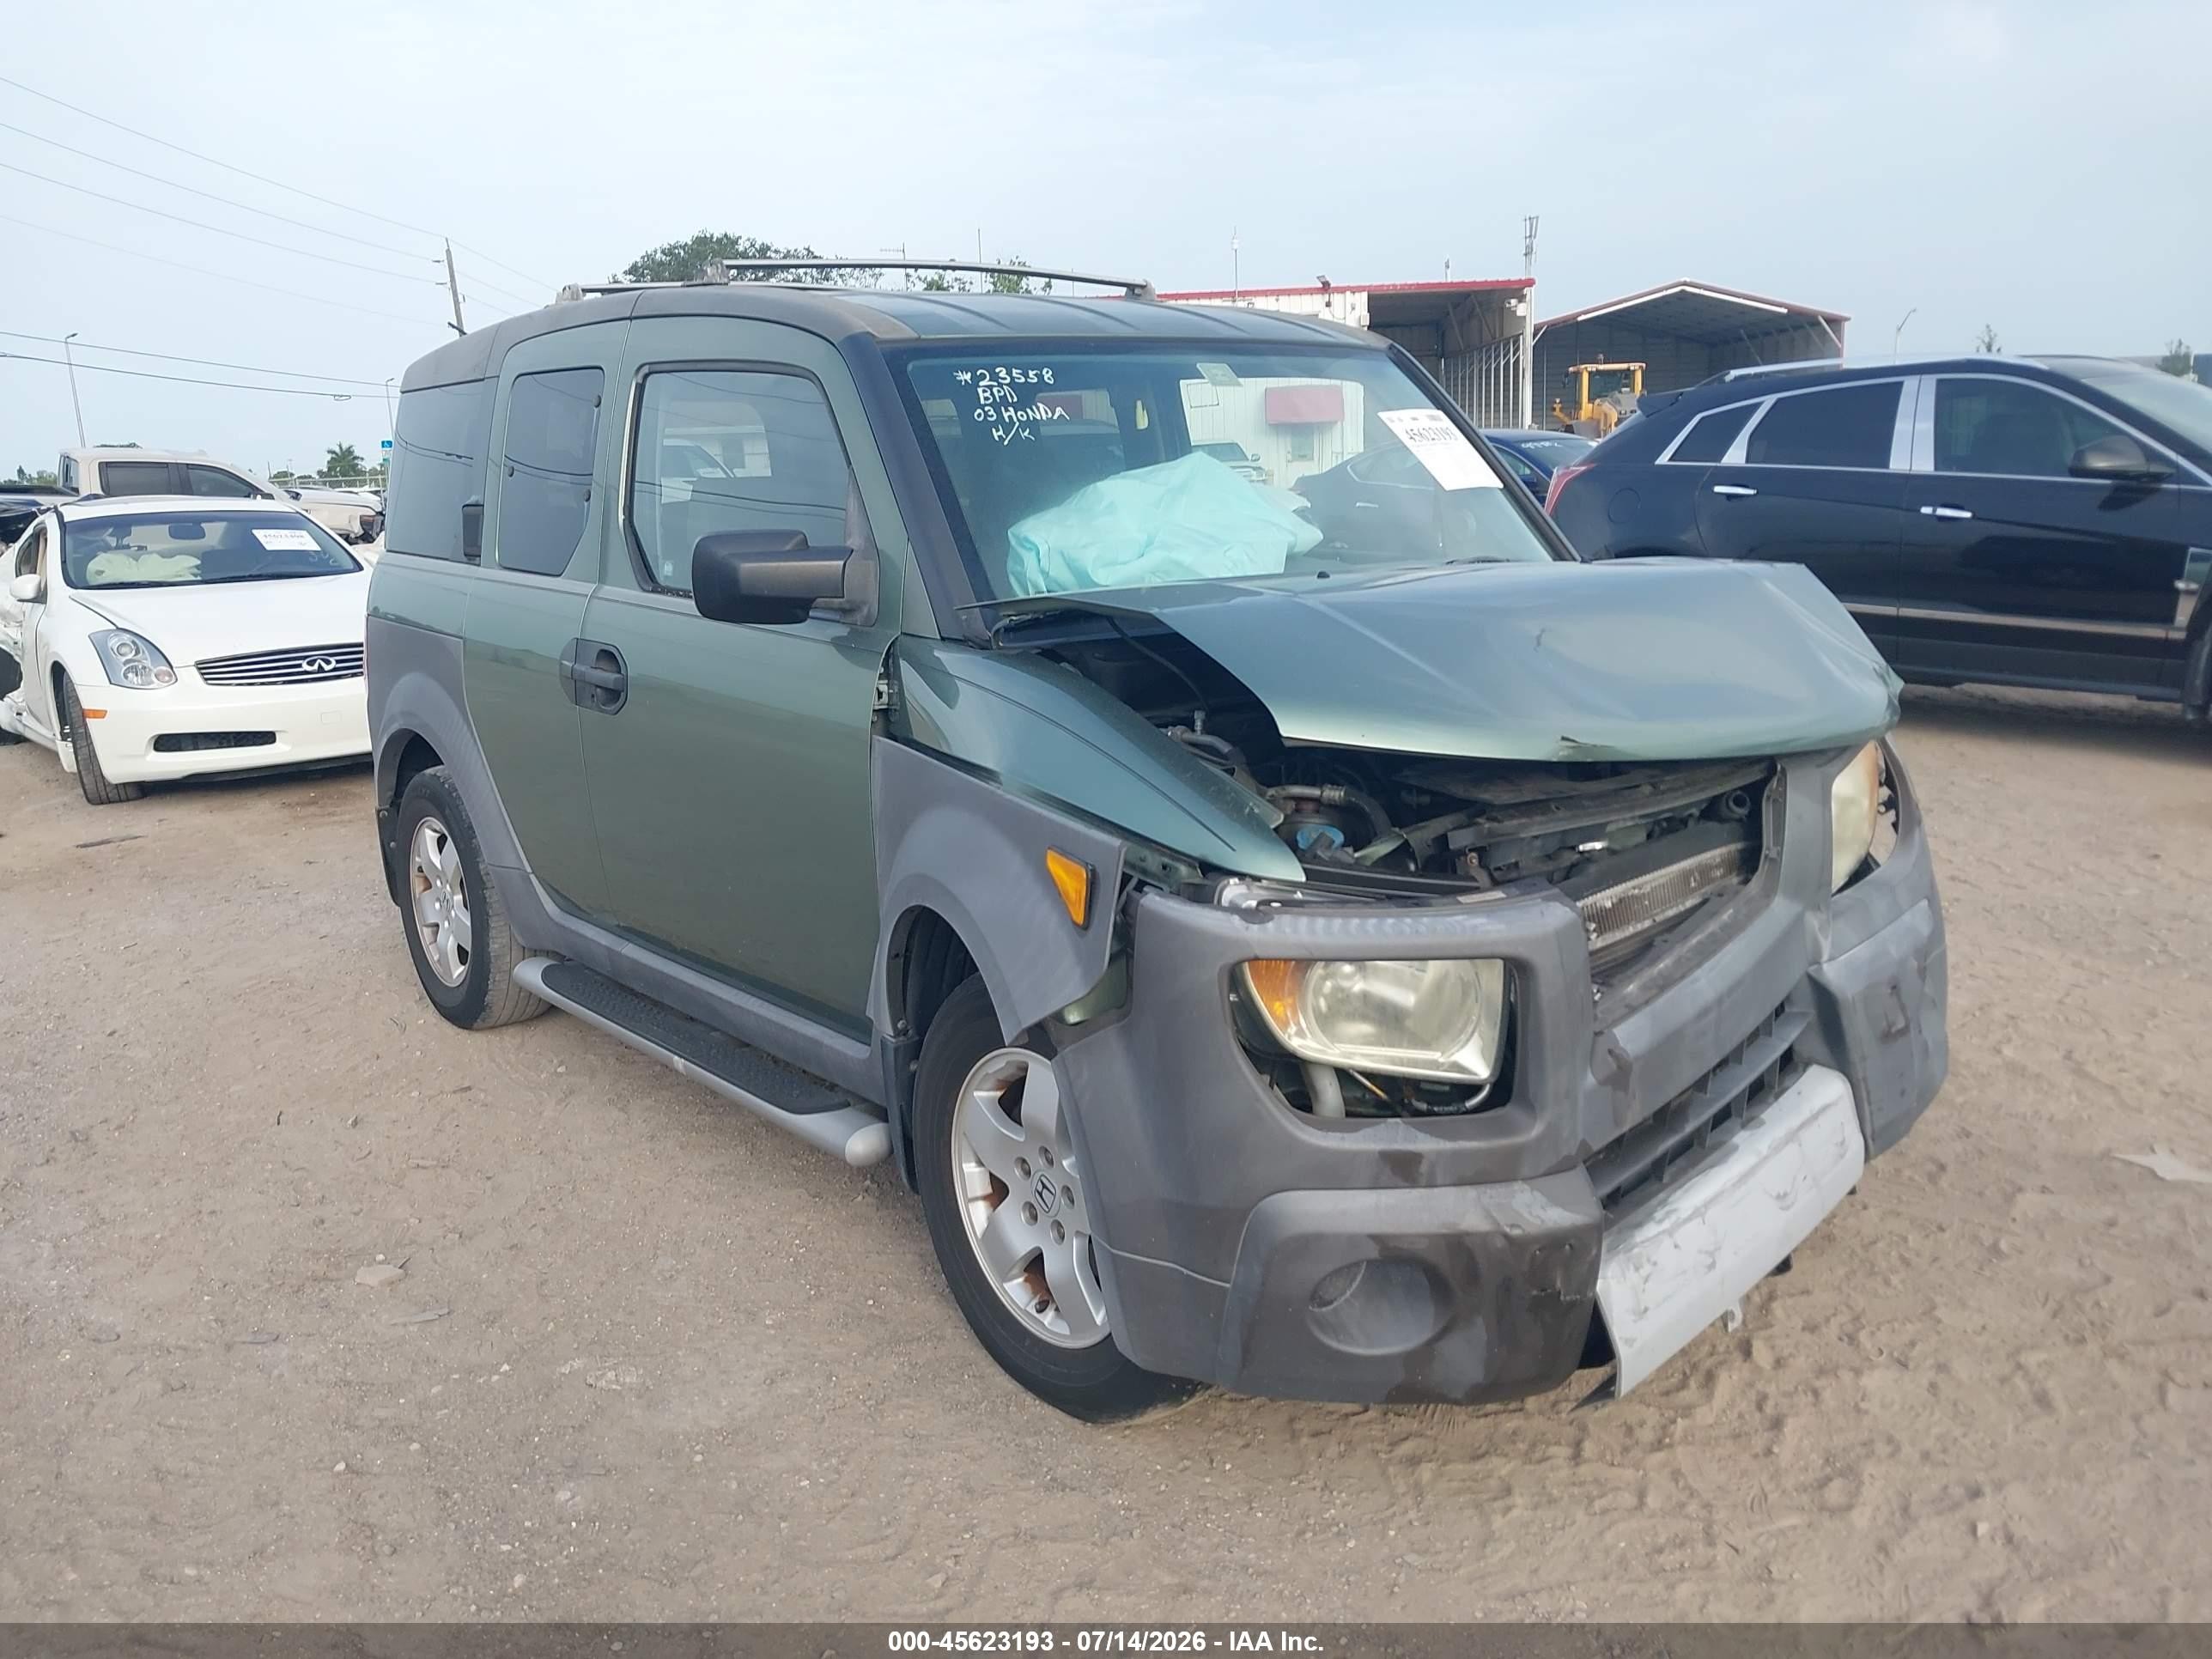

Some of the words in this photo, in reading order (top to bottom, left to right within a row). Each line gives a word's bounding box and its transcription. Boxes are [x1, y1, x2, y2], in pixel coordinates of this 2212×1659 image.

[977, 385, 1018, 405] BPD
[974, 406, 996, 422] 03
[1001, 402, 1070, 423] HONDA
[992, 422, 1036, 446] H/K
